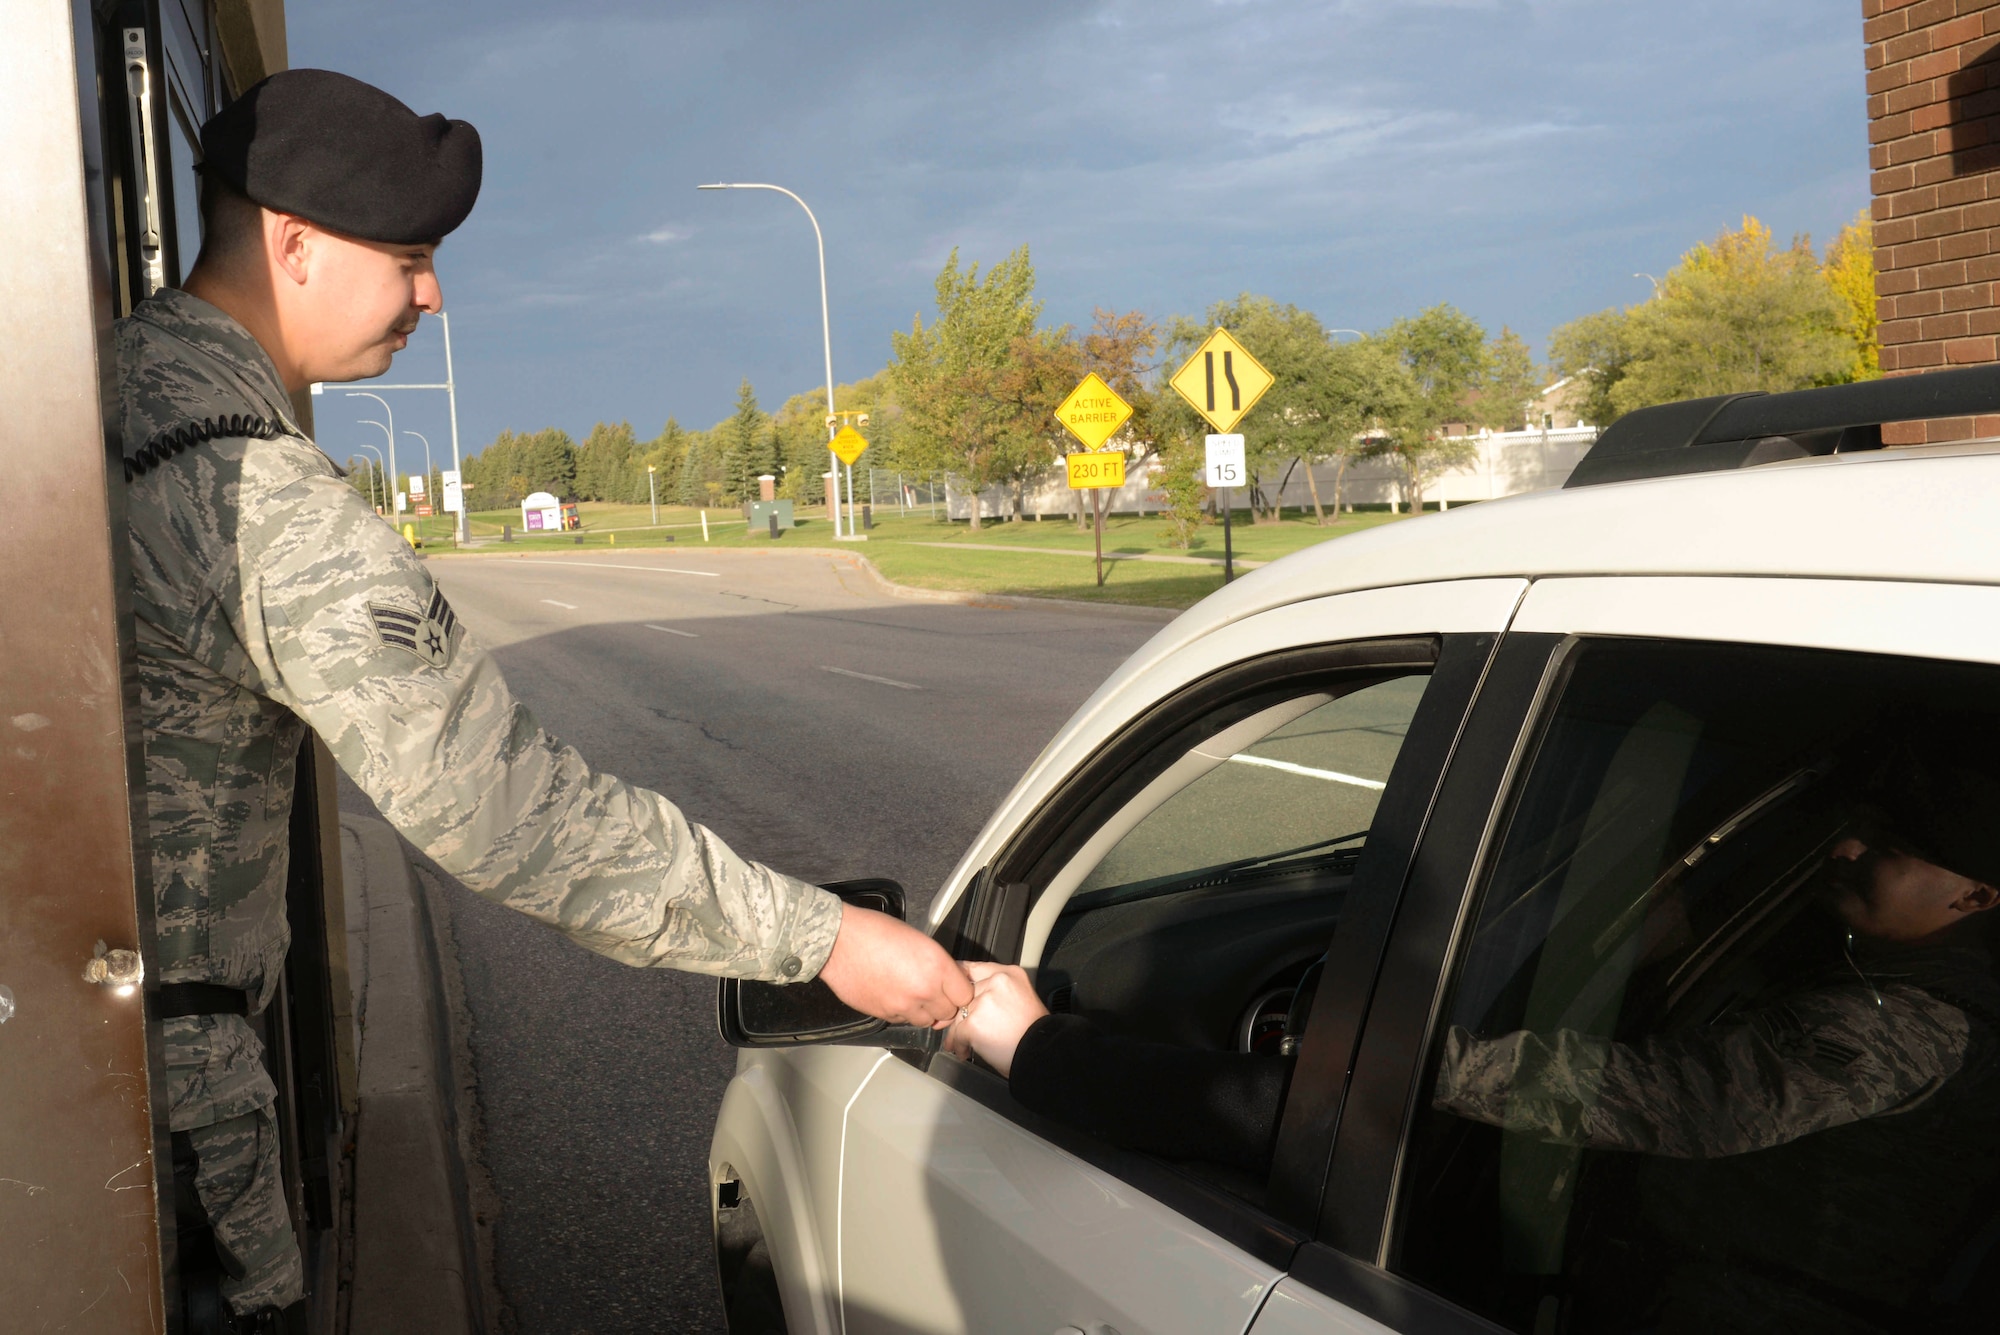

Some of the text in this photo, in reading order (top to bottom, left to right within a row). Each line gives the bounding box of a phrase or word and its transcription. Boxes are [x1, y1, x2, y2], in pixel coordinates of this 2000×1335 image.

[1074, 398, 1112, 409] ACTIVE
[1070, 412, 1117, 424] BARRIER
[1073, 462, 1119, 479] 230 FT
[1214, 464, 1236, 481] 15
